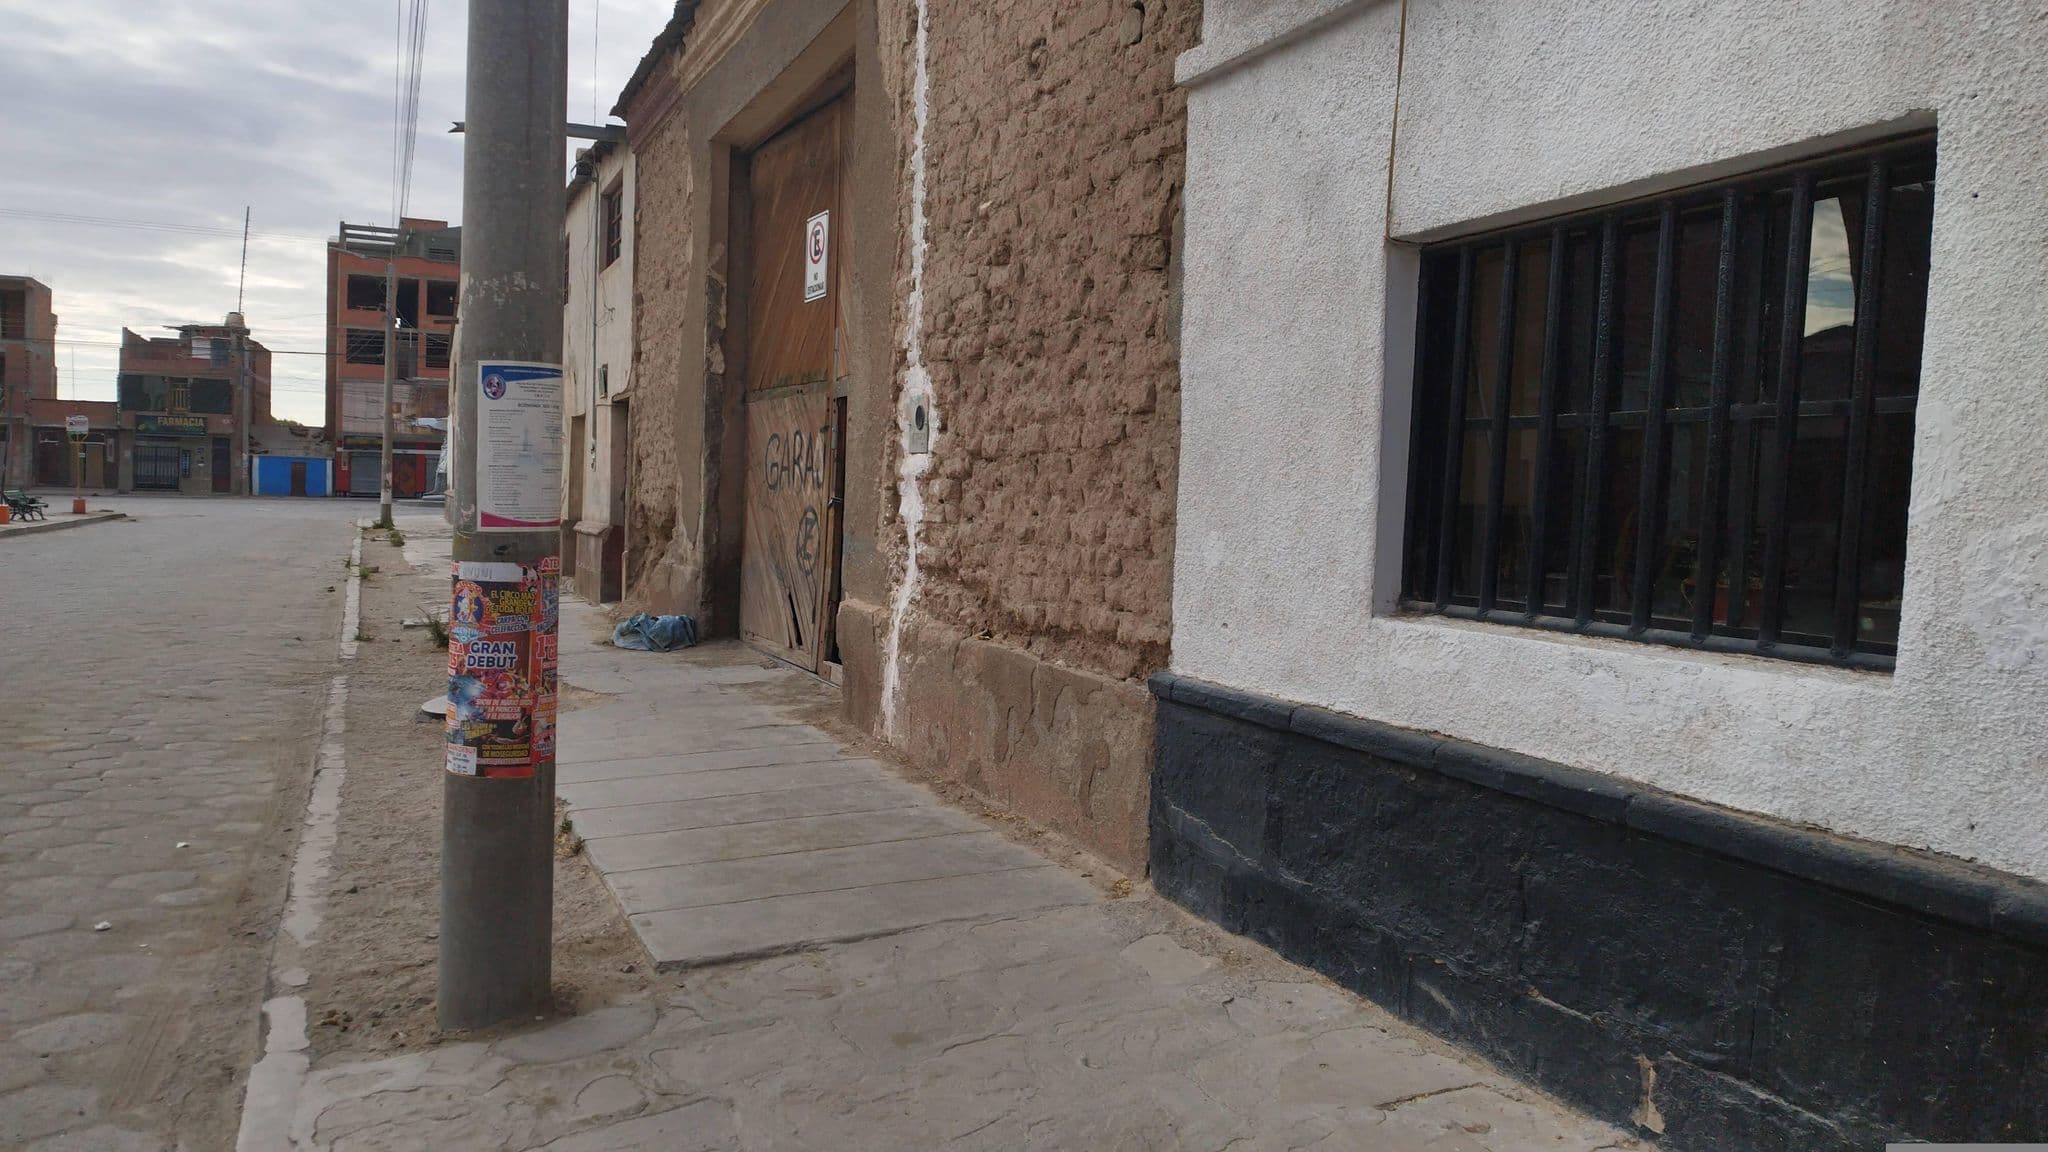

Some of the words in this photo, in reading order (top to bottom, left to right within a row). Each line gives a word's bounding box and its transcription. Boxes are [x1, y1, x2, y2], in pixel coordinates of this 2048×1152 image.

[158, 416, 204, 427] FARMACIA
[471, 641, 515, 655] GRAN
[467, 655, 516, 668] DEBUT
